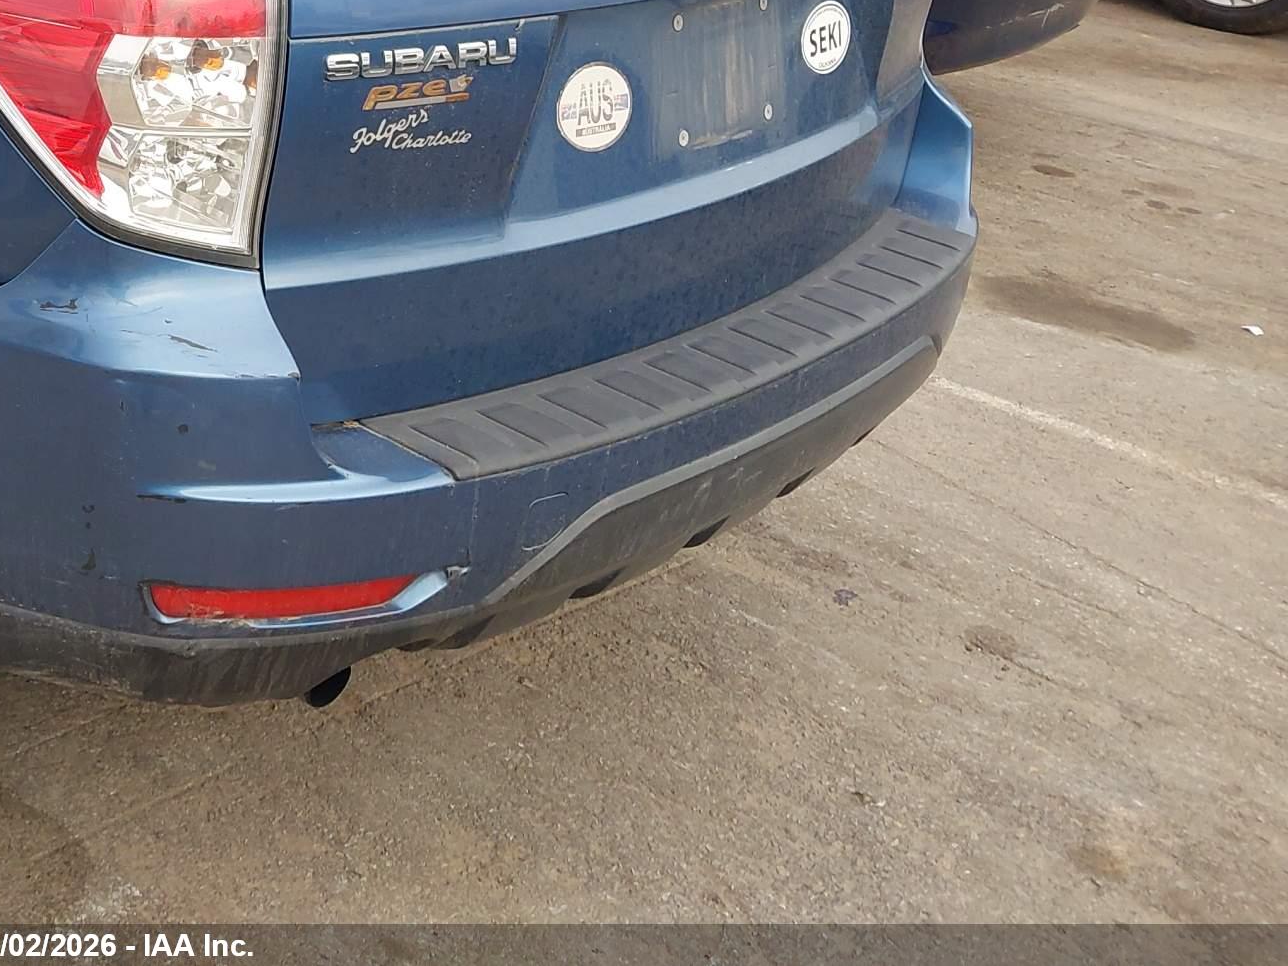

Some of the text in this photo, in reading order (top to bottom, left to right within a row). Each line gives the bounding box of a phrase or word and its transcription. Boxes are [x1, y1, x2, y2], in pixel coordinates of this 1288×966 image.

[325, 37, 517, 82] SUBARU
[809, 19, 842, 58] SEKI
[577, 78, 614, 126] AUS
[391, 129, 472, 150] Charlotte
